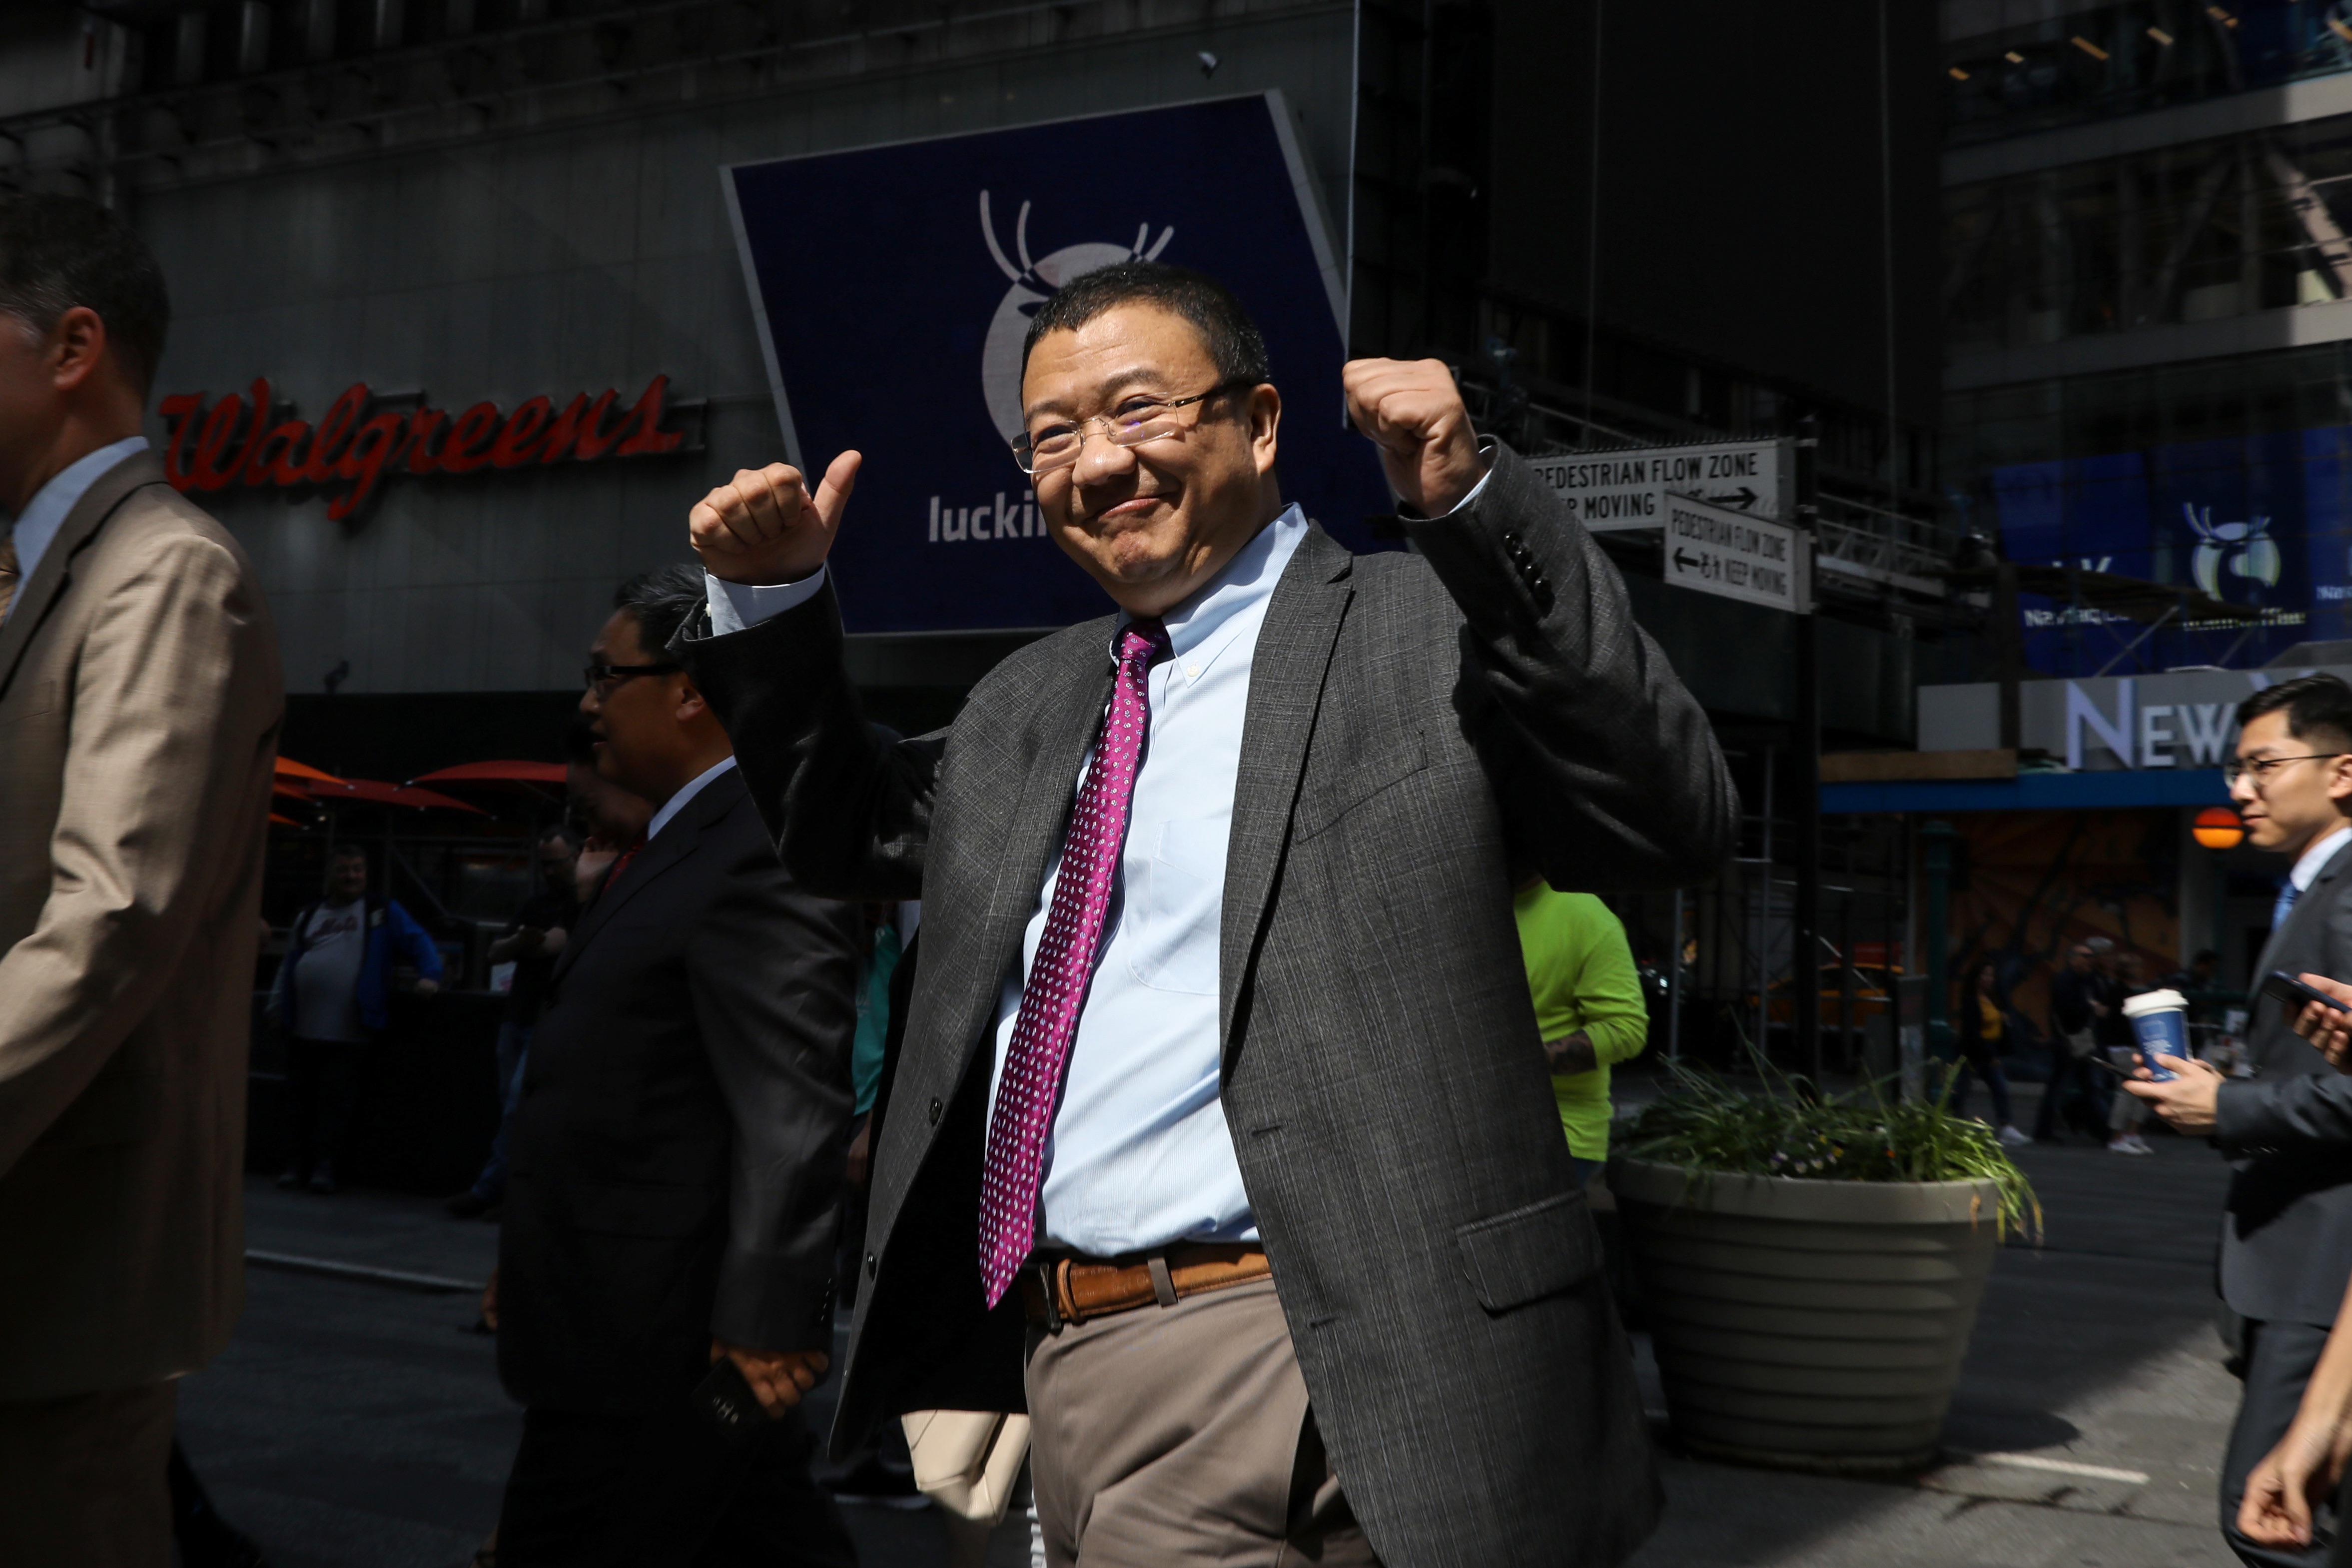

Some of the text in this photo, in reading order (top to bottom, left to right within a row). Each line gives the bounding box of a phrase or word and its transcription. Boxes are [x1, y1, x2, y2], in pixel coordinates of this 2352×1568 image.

[159, 374, 685, 521] Walgreens
[1652, 457, 1701, 482] FLOW
[1709, 453, 1758, 478] ZONE
[1584, 493, 1654, 519] MOVING
